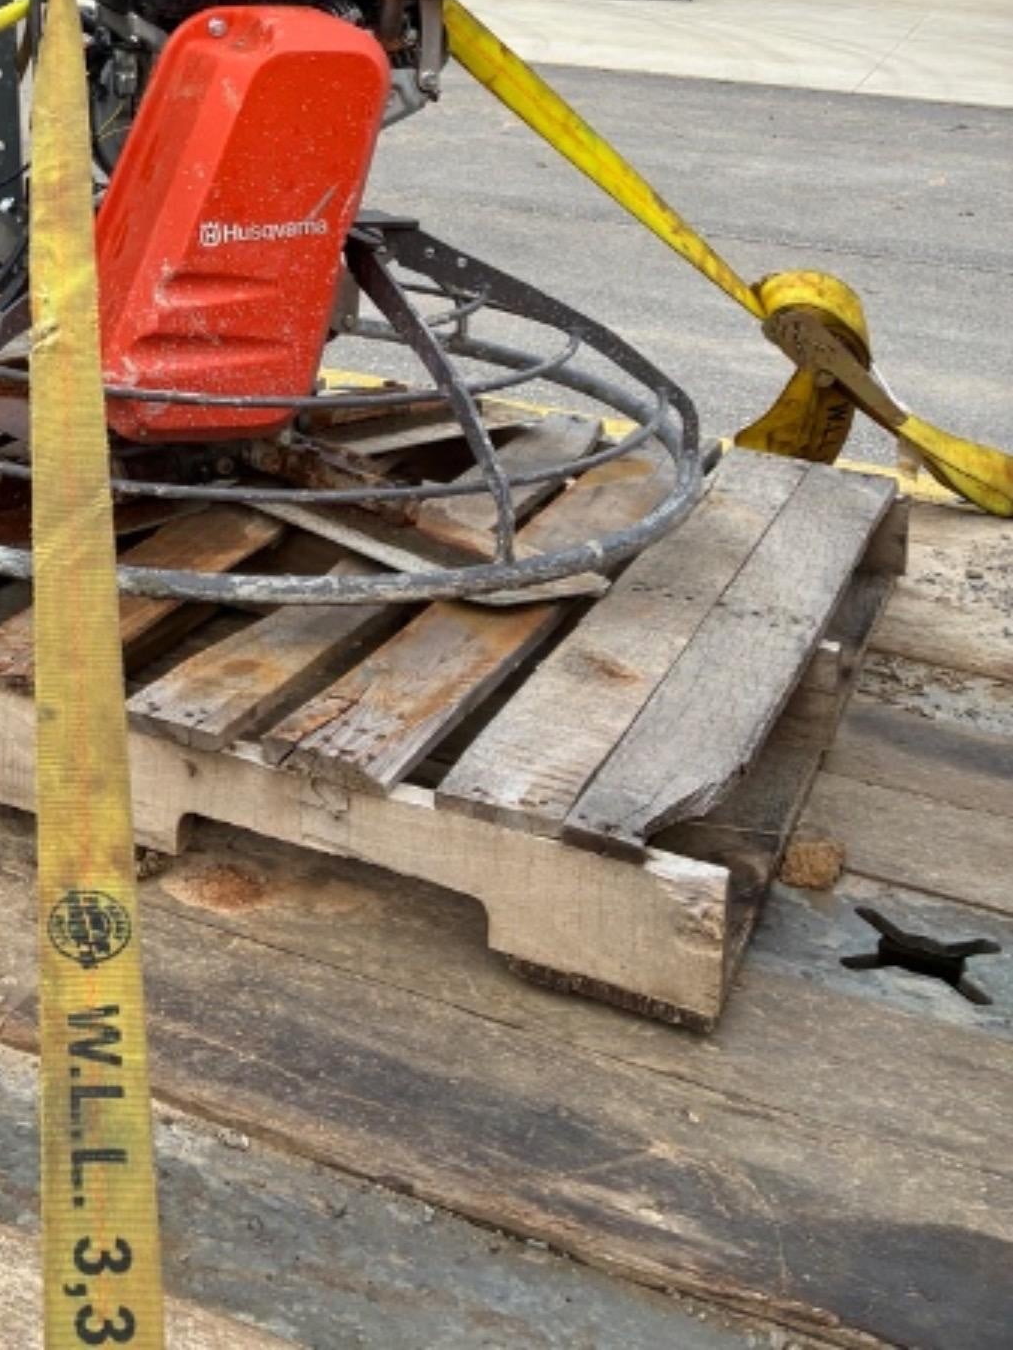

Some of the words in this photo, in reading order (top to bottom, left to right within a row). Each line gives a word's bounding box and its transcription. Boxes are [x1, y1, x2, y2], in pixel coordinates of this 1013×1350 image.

[223, 218, 328, 244] Husqvarna
[67, 1004, 127, 1208] W.L.L.
[63, 1236, 136, 1345] 3,3
